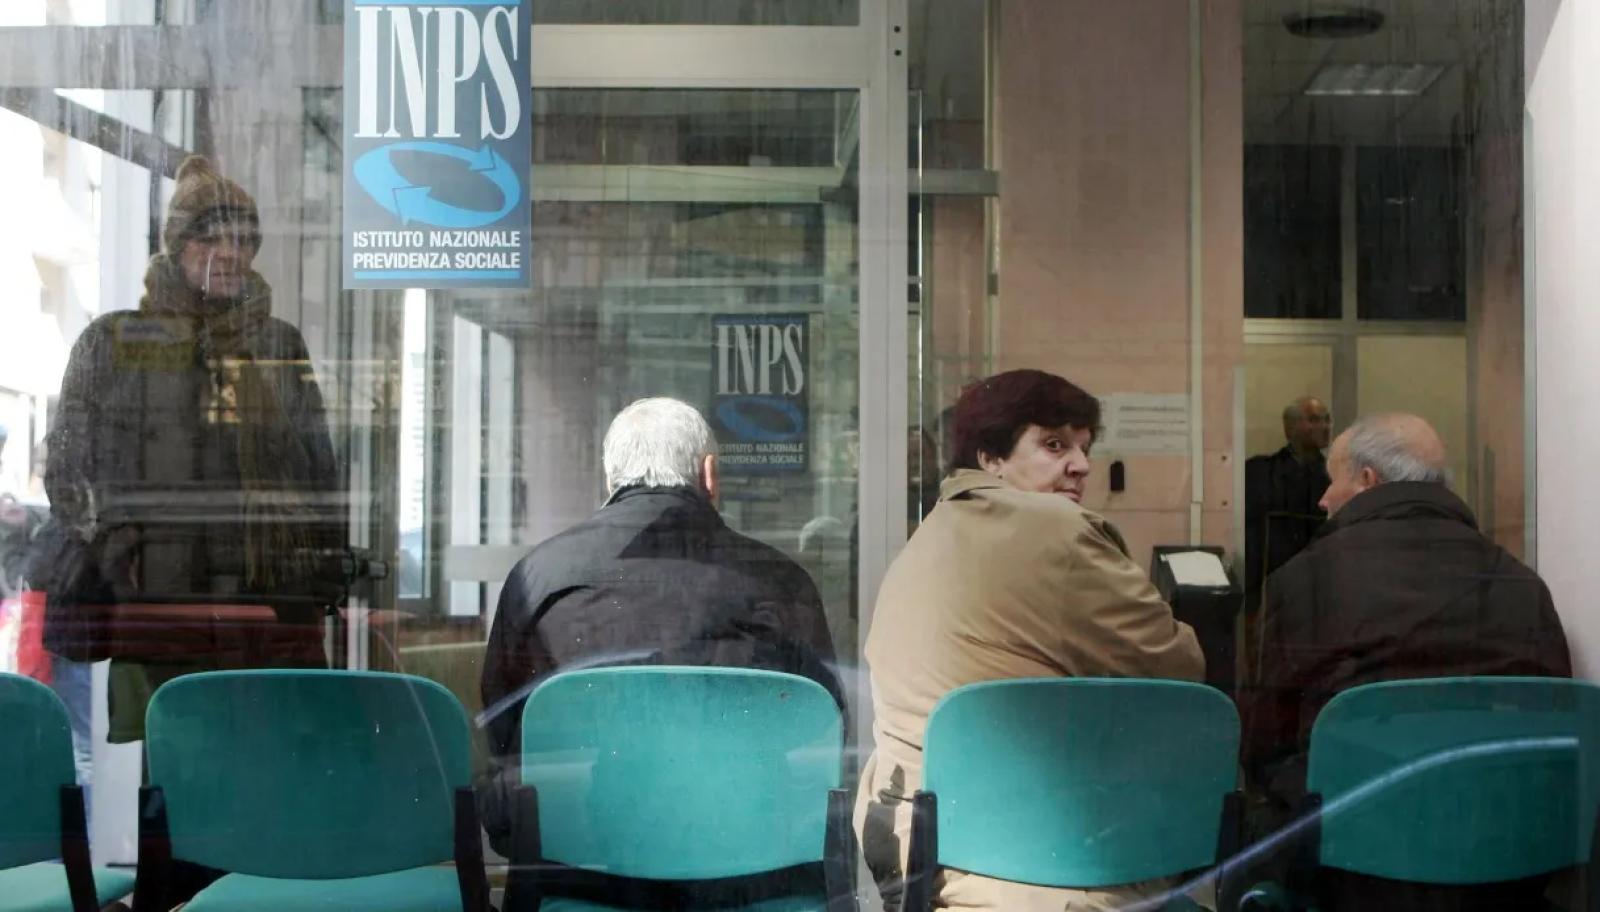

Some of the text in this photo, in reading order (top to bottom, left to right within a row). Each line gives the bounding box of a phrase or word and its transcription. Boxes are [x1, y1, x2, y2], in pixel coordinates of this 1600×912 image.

[354, 5, 520, 140] INPS
[353, 231, 520, 248] ISTITUTO NAZIONALE
[353, 252, 520, 269] PREVIDENZA SOCIALE
[716, 324, 804, 396] INPS
[756, 443, 804, 453] NAZIONALE
[770, 455, 804, 465] SOCIALE
